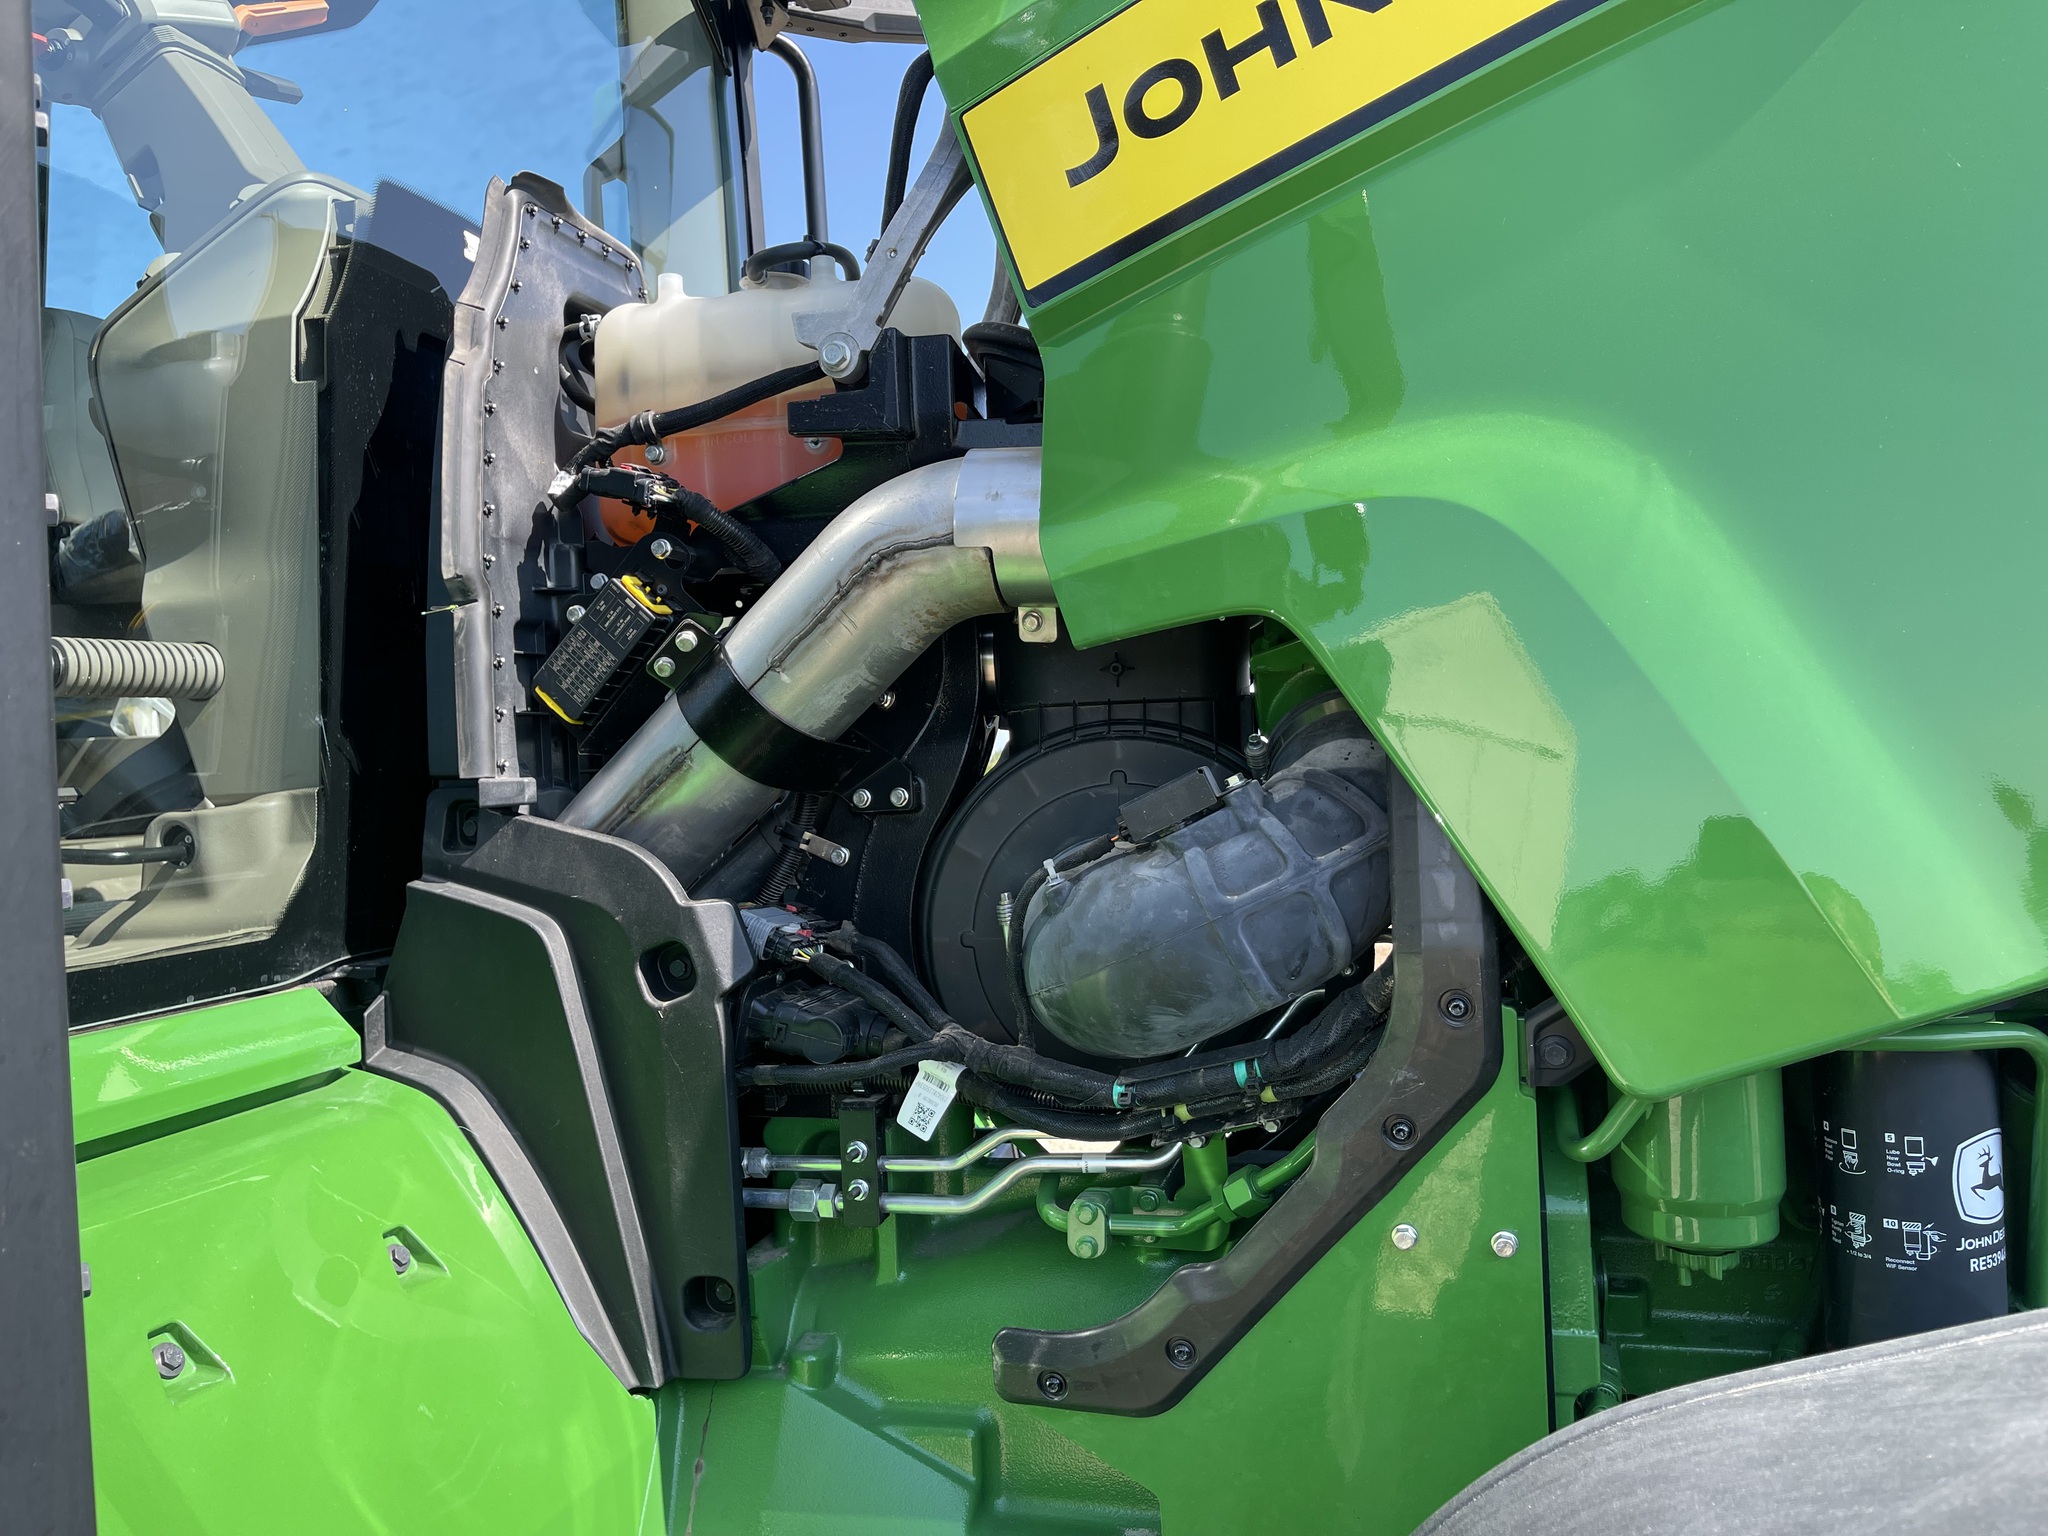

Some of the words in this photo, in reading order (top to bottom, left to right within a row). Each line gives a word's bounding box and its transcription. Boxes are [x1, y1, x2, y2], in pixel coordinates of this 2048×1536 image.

[1887, 1167, 1905, 1175] O-ring
[1955, 1234, 1993, 1251] JOHN
[1885, 1256, 1915, 1265] Reconnect
